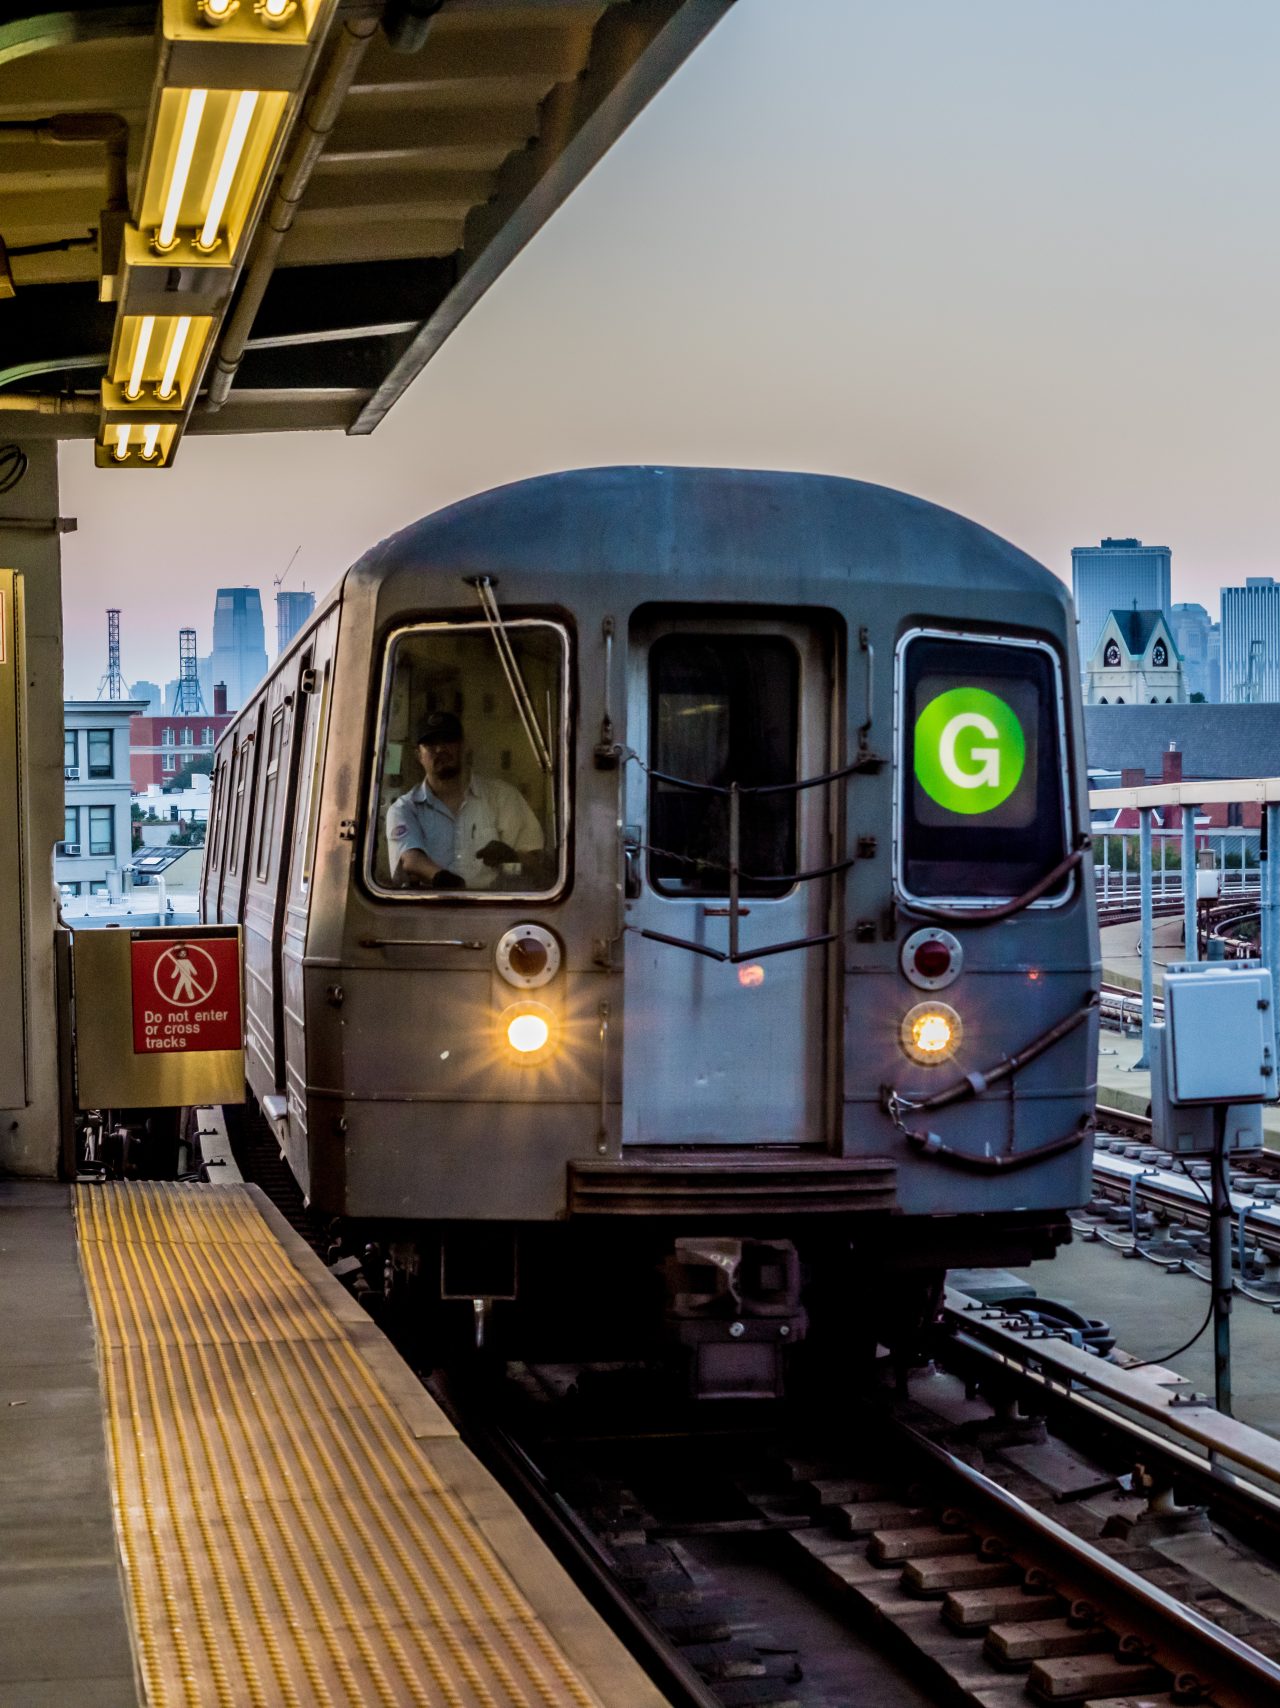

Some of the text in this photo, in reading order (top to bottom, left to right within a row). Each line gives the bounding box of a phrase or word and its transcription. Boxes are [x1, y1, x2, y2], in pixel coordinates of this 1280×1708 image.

[939, 712, 999, 789] G
[144, 1009, 228, 1023] Do not enter
[145, 1023, 200, 1035] or cross
[146, 1035, 187, 1048] tracks
